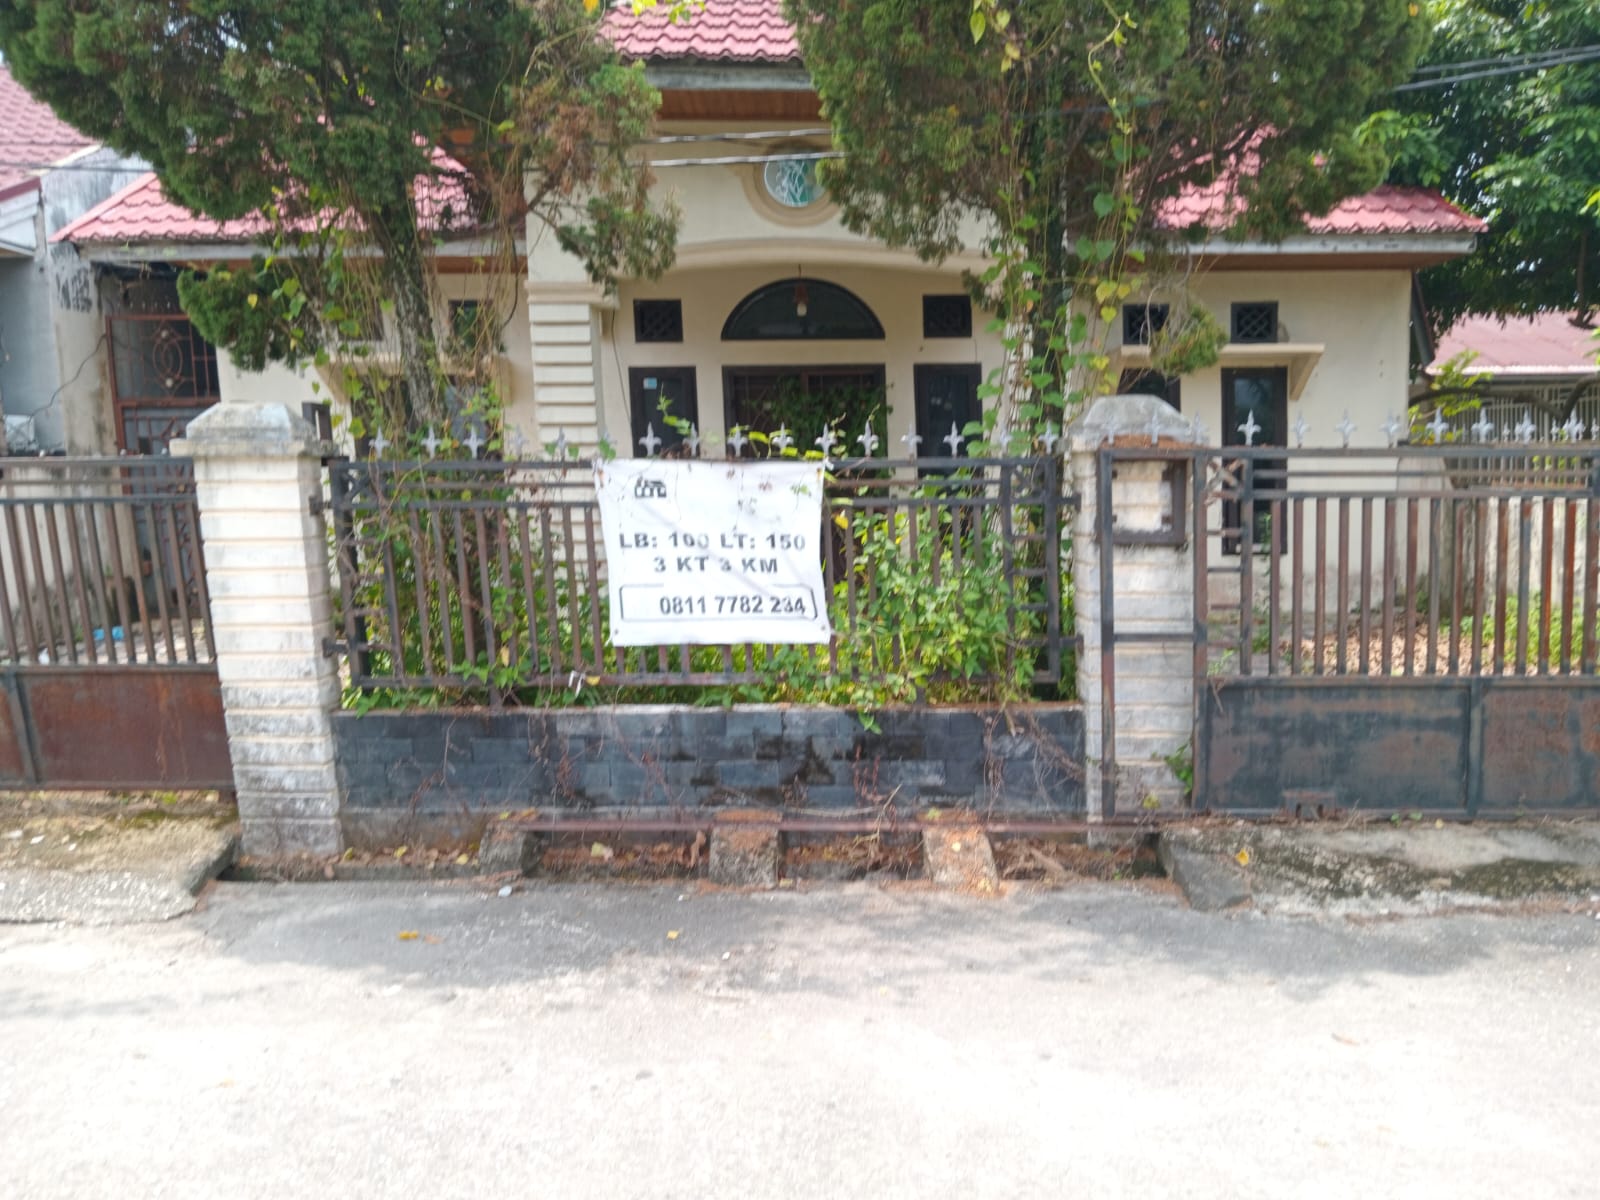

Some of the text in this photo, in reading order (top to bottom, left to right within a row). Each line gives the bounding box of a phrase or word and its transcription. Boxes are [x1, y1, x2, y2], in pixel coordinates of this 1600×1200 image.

[619, 532, 657, 549] LB:
[720, 533, 755, 550] LT:
[766, 532, 806, 551] 150
[653, 556, 667, 573] 3
[677, 555, 709, 573] KT
[741, 557, 778, 574] KM
[659, 595, 806, 615] 0811 7782 234
